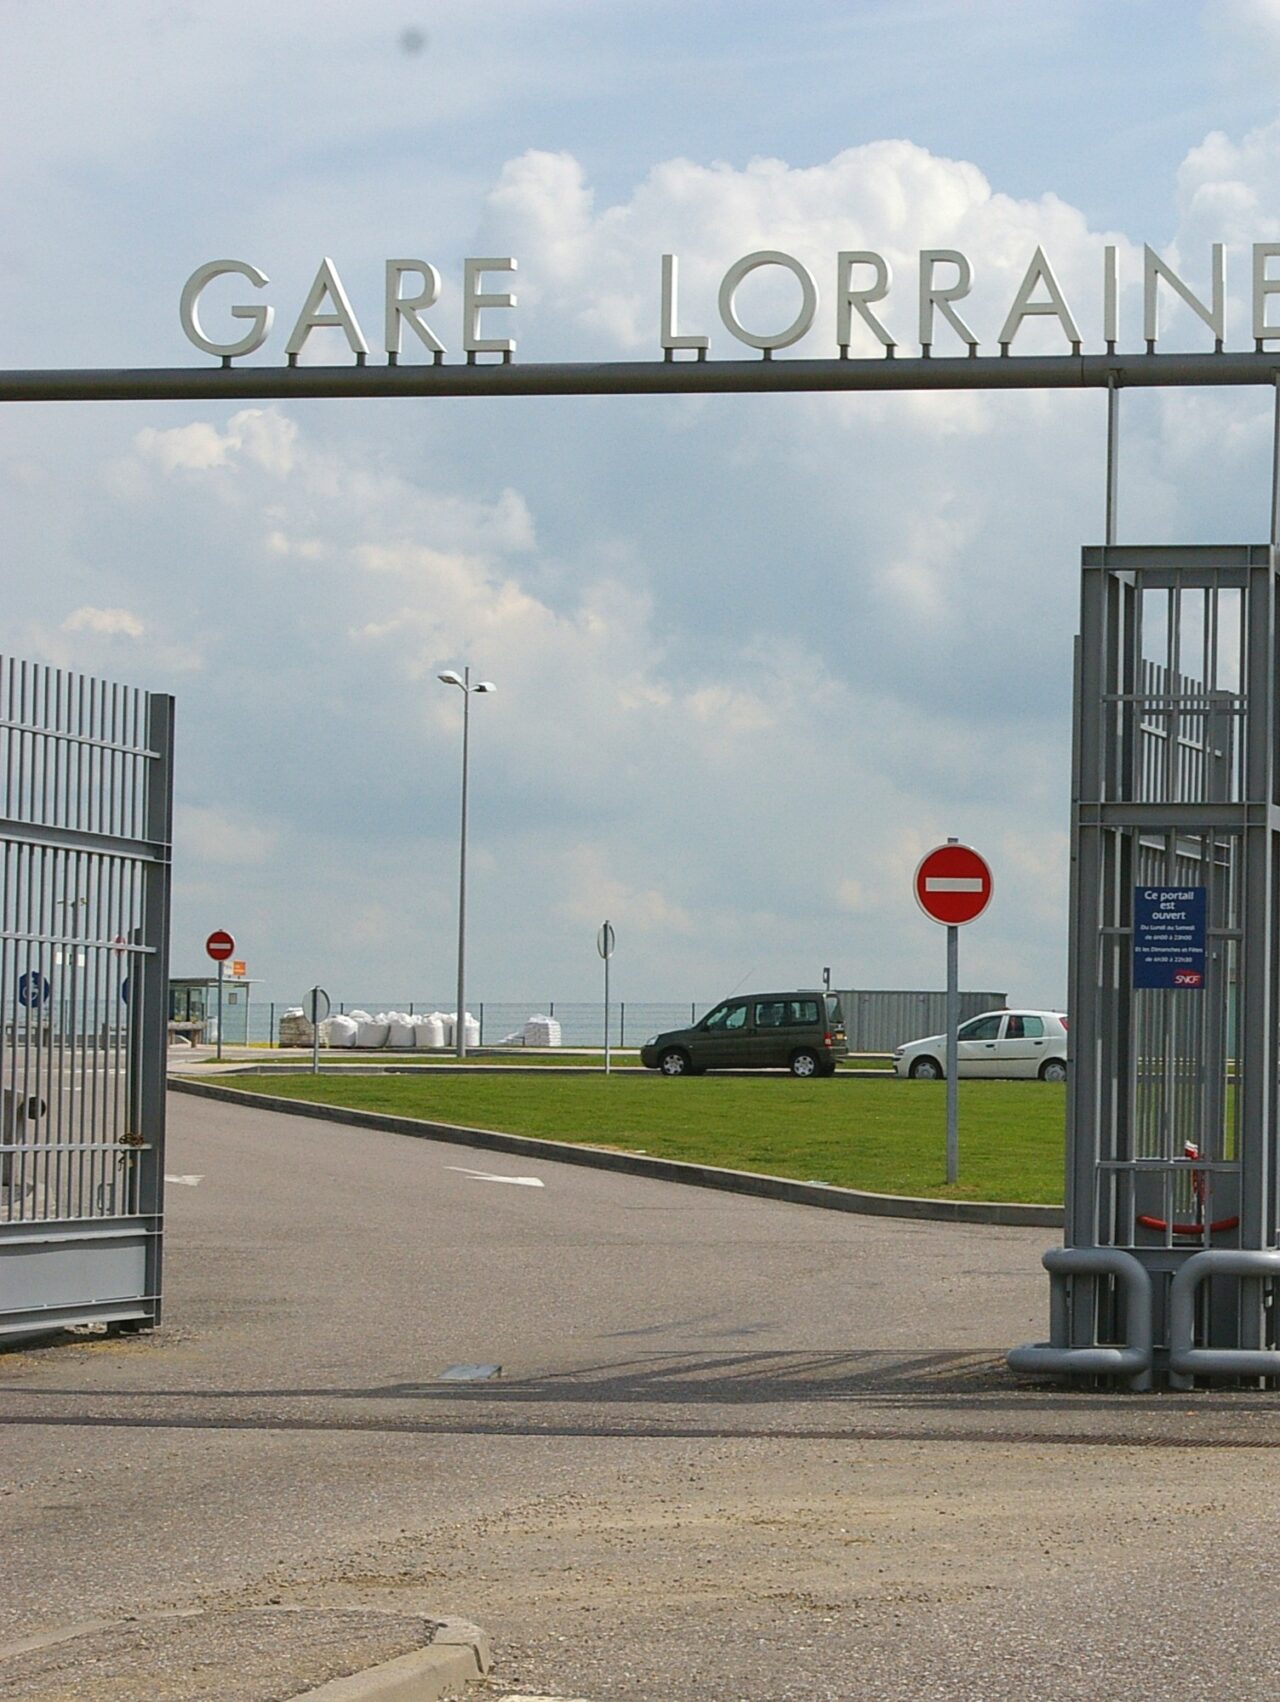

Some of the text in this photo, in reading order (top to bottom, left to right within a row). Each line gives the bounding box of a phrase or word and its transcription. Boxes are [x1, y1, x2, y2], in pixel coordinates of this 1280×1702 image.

[179, 256, 518, 357] GARE
[1144, 890, 1194, 902] Ce portail
[1160, 902, 1176, 910] est
[1152, 911, 1186, 920] ouvert
[1174, 975, 1201, 984] SNCF
